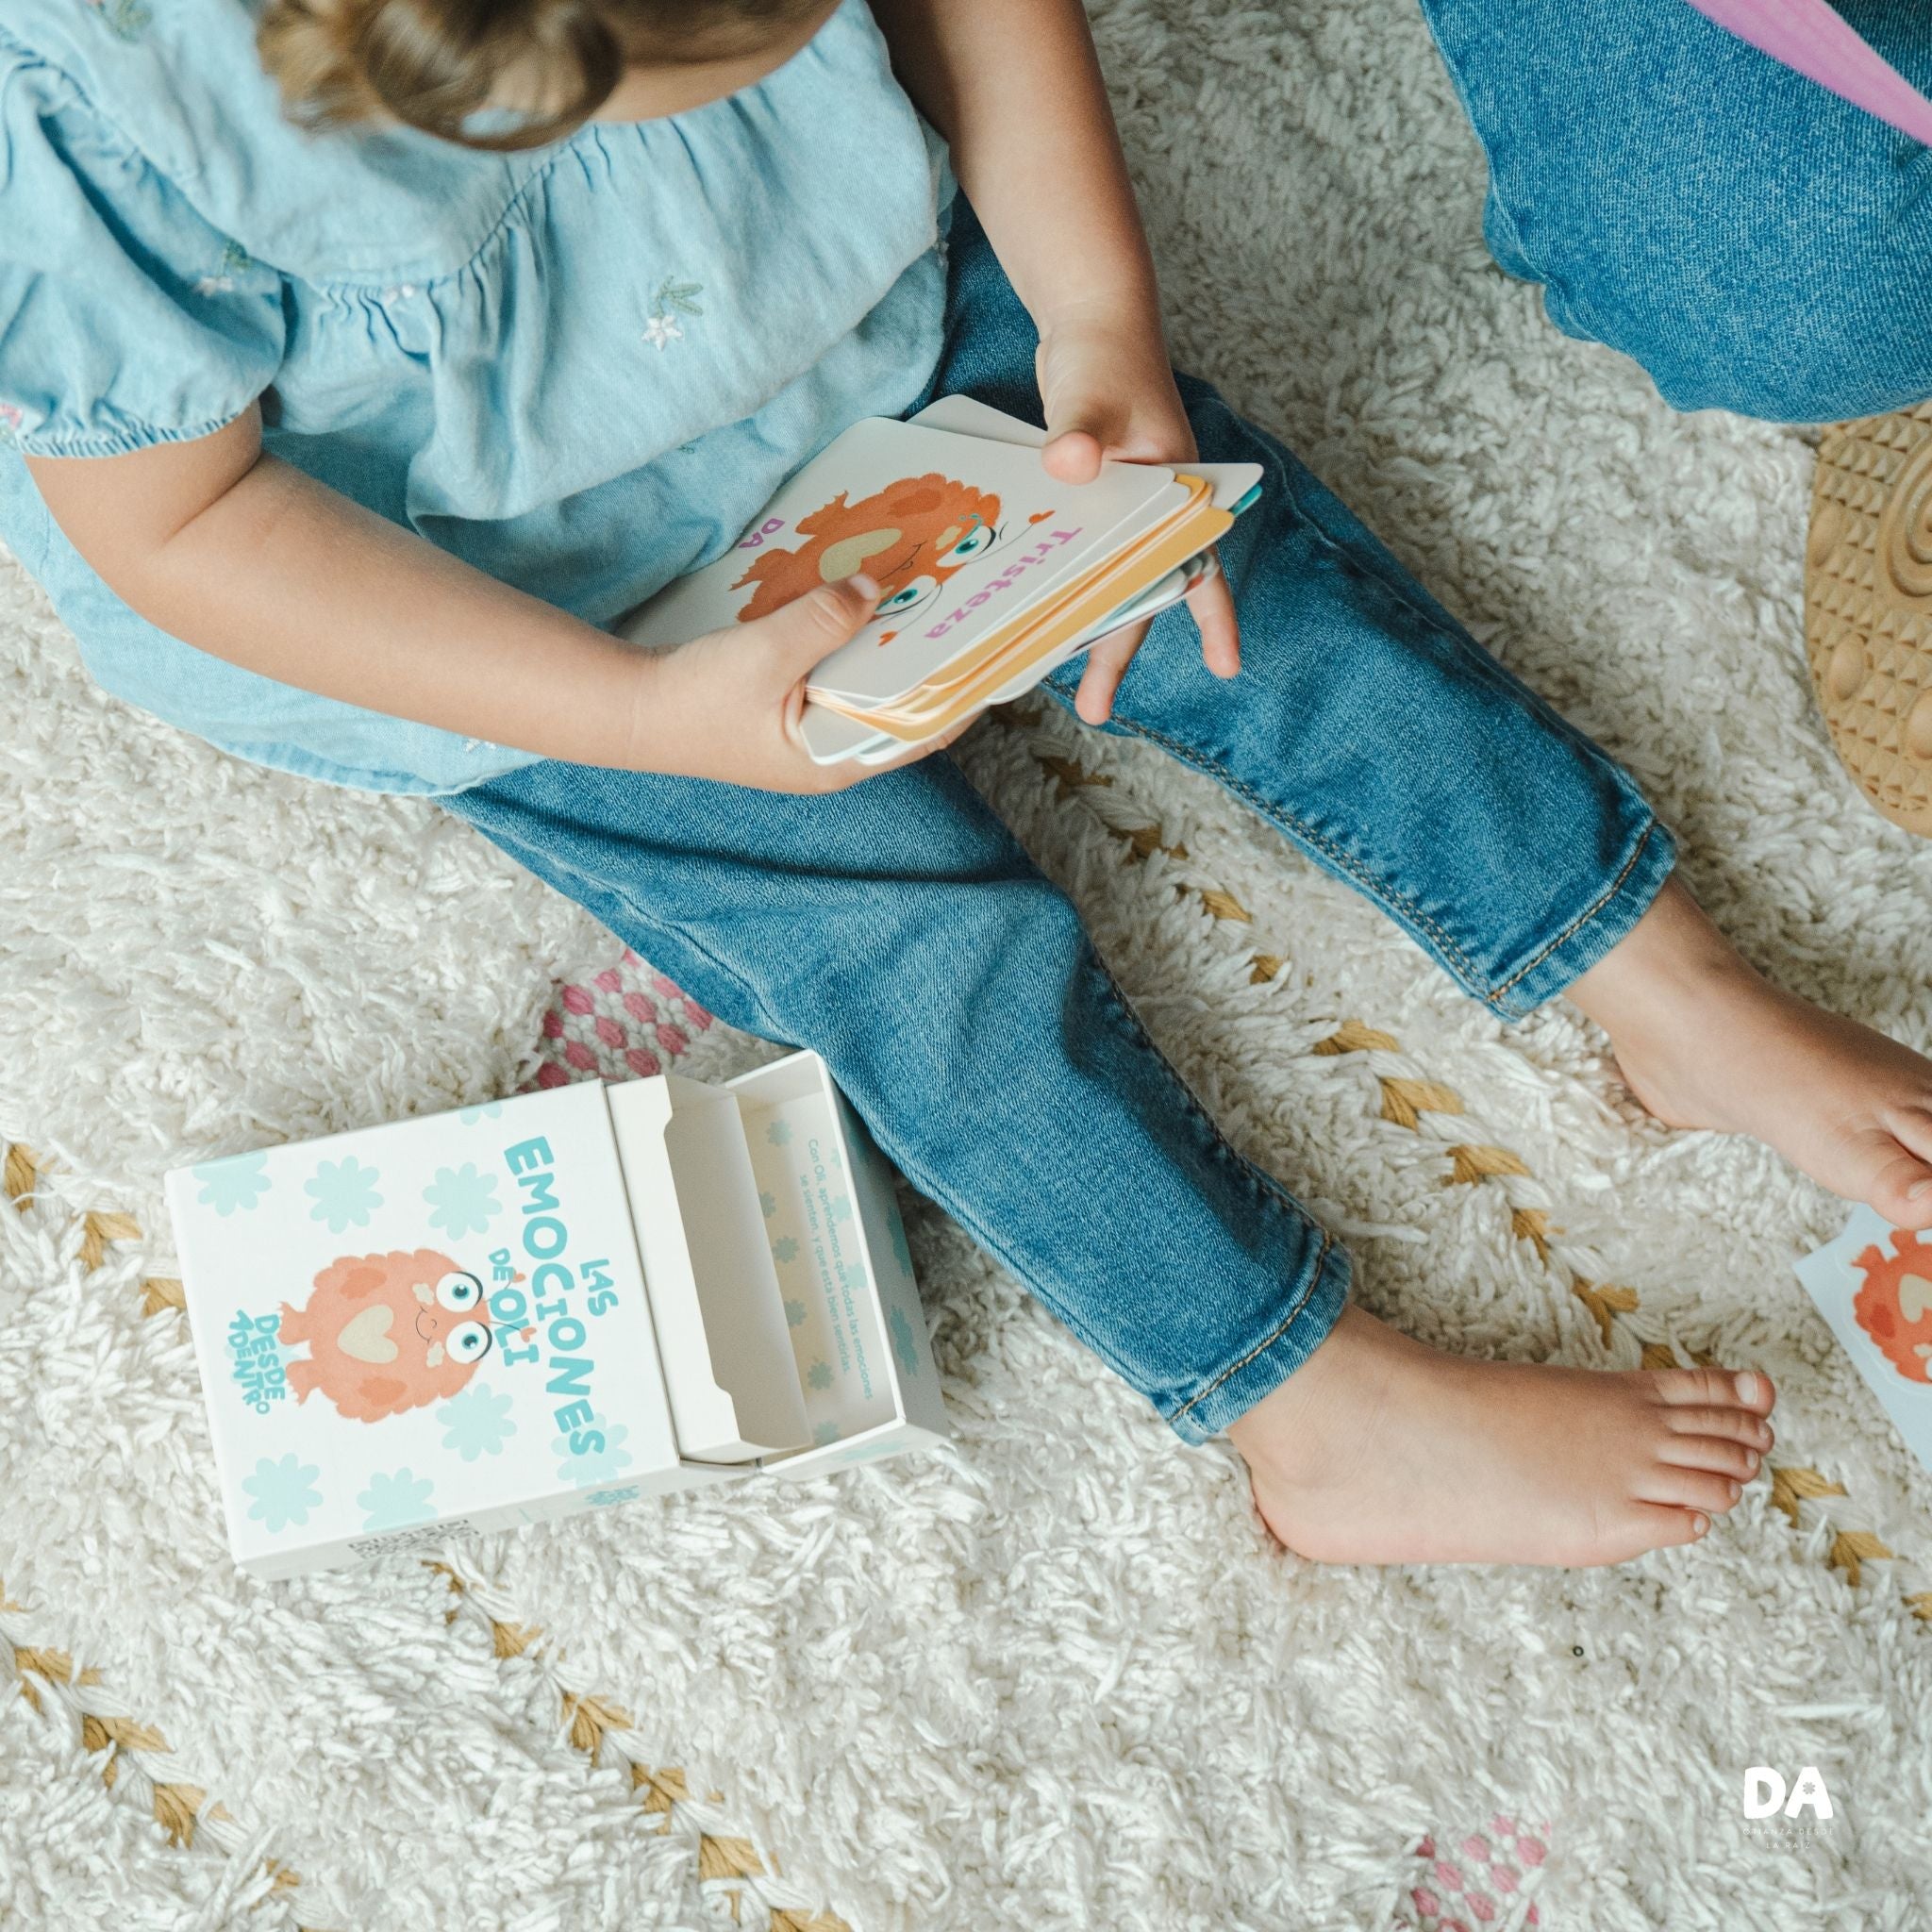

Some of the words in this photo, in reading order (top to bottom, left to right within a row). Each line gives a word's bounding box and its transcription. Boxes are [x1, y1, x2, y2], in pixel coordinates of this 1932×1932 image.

[739, 518, 785, 548] DA
[924, 527, 1084, 639] Tristeza
[808, 1139, 820, 1163] Con
[799, 1174, 808, 1187] se
[814, 1245, 826, 1267] que
[827, 1296, 839, 1321] bien
[819, 1188, 841, 1258] aprendemos
[489, 1248, 516, 1282] DE
[580, 1258, 619, 1317] LAS
[834, 1260, 847, 1281] que
[504, 1136, 606, 1457] EMOCIONES
[841, 1284, 855, 1317] todas
[250, 1314, 286, 1400] DESDE
[490, 1289, 540, 1367] OLI
[849, 1320, 858, 1336] las
[227, 1309, 270, 1414] ADENTRO
[853, 1338, 873, 1399] emociones
